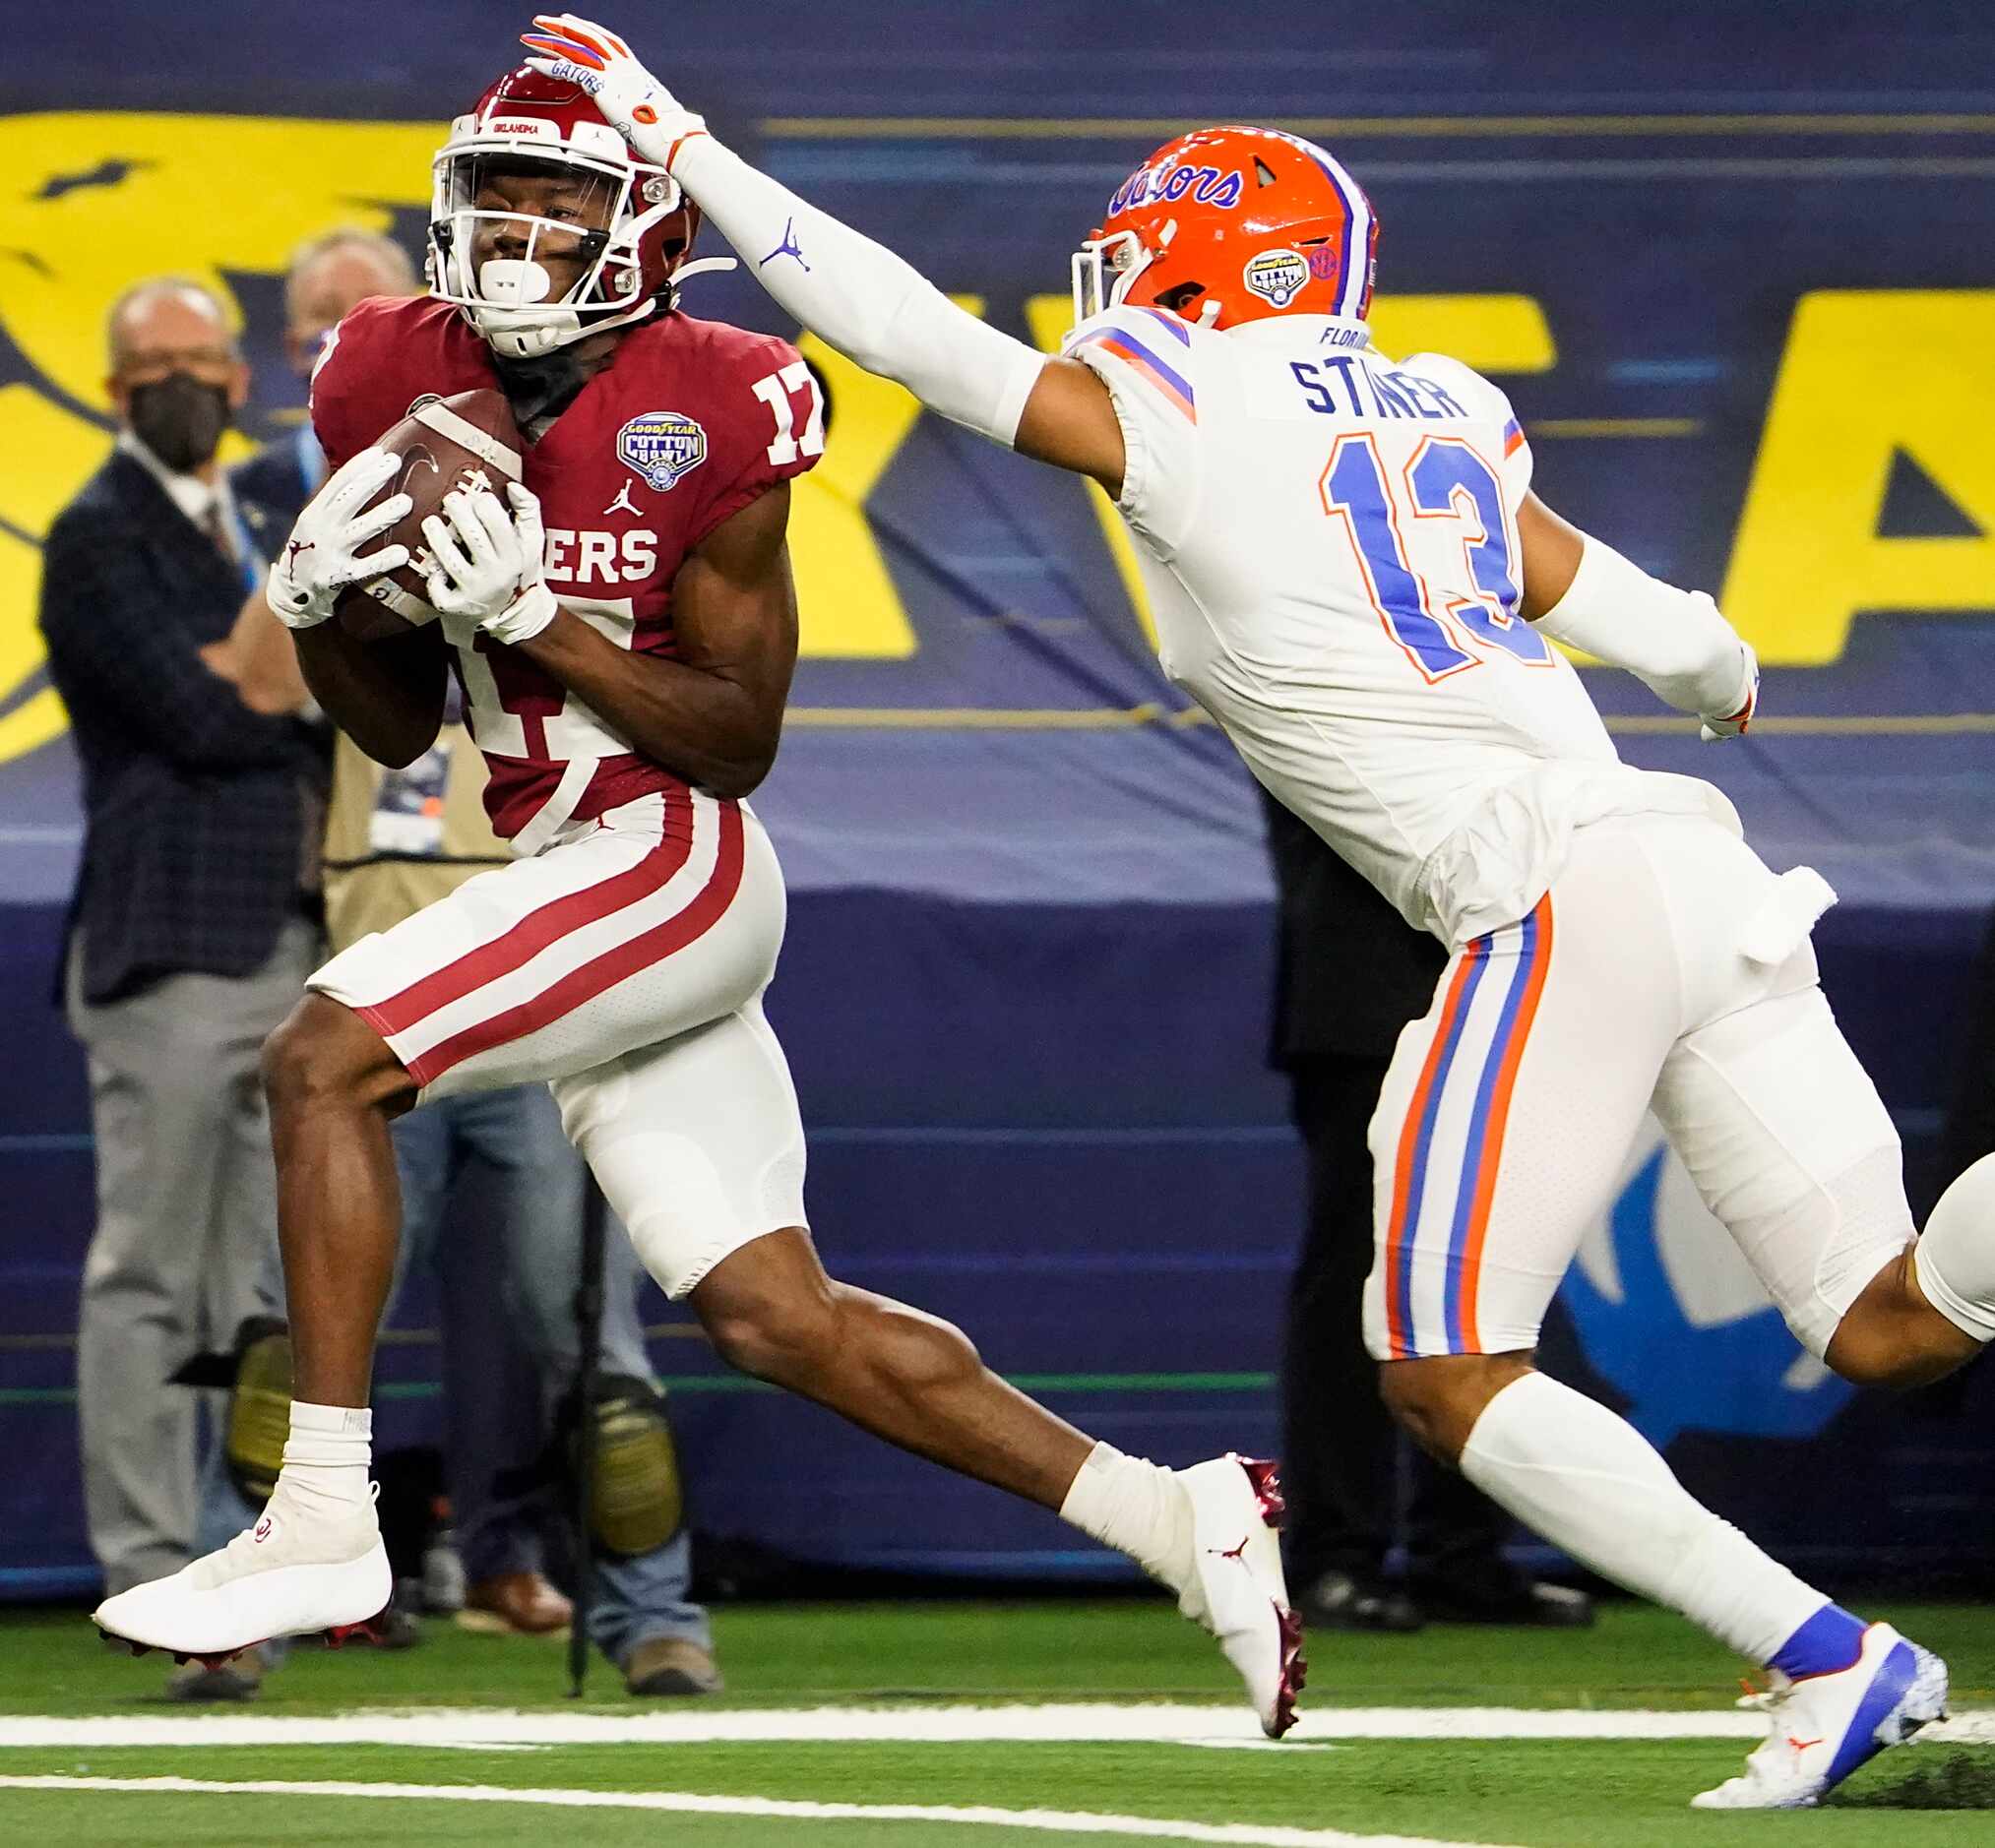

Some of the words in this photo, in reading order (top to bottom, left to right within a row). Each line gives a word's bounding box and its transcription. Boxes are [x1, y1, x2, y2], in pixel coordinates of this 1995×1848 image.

[551, 61, 605, 93] GATORS
[1289, 355, 1469, 418] STINER
[628, 423, 696, 435] GOODYEAR
[751, 360, 825, 466] 17
[625, 435, 699, 461] COTTON
[638, 449, 686, 464] BOWL
[543, 528, 657, 584] ERS
[1319, 432, 1555, 685] 13
